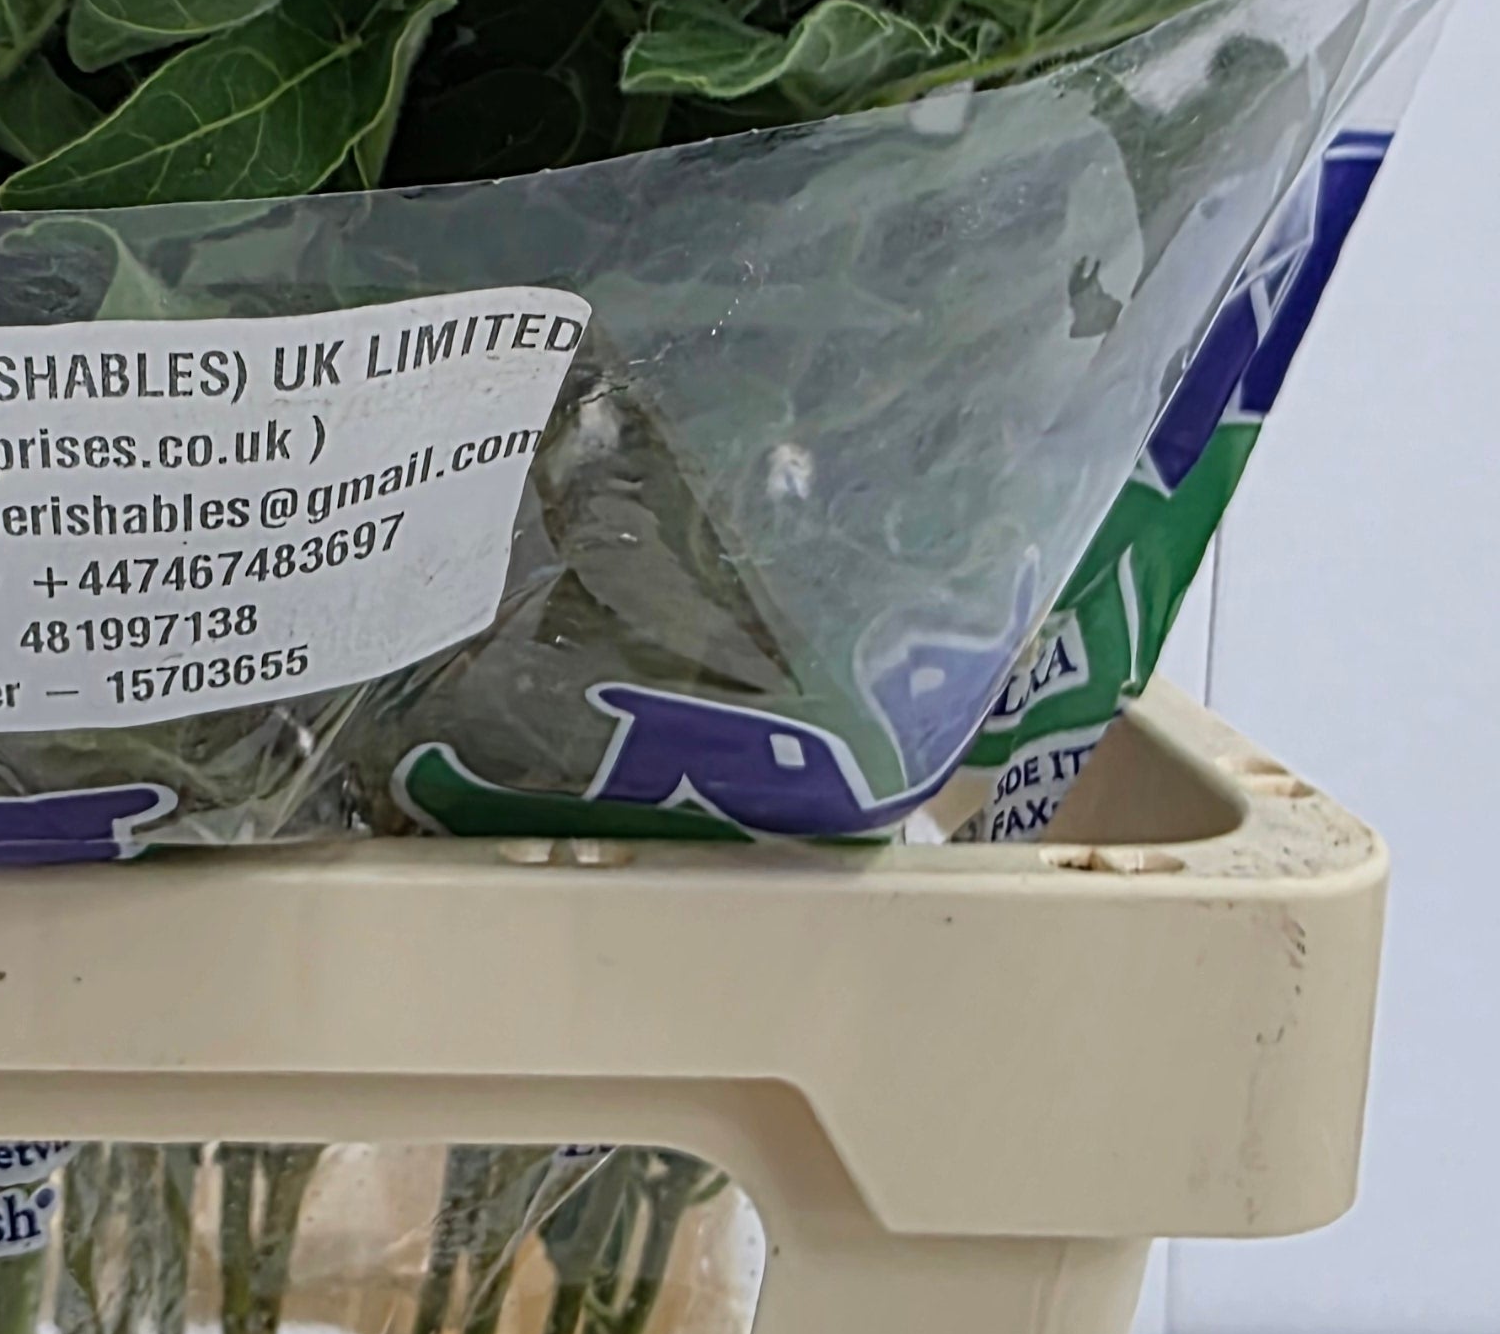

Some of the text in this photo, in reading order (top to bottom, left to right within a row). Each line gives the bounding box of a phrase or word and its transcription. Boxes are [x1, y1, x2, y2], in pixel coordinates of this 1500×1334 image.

[273, 341, 346, 391] UK
[367, 313, 583, 379] LIMITED
[32, 511, 406, 598] +447467483697
[19, 603, 259, 654] 481997138
[105, 644, 310, 706] 15703655
